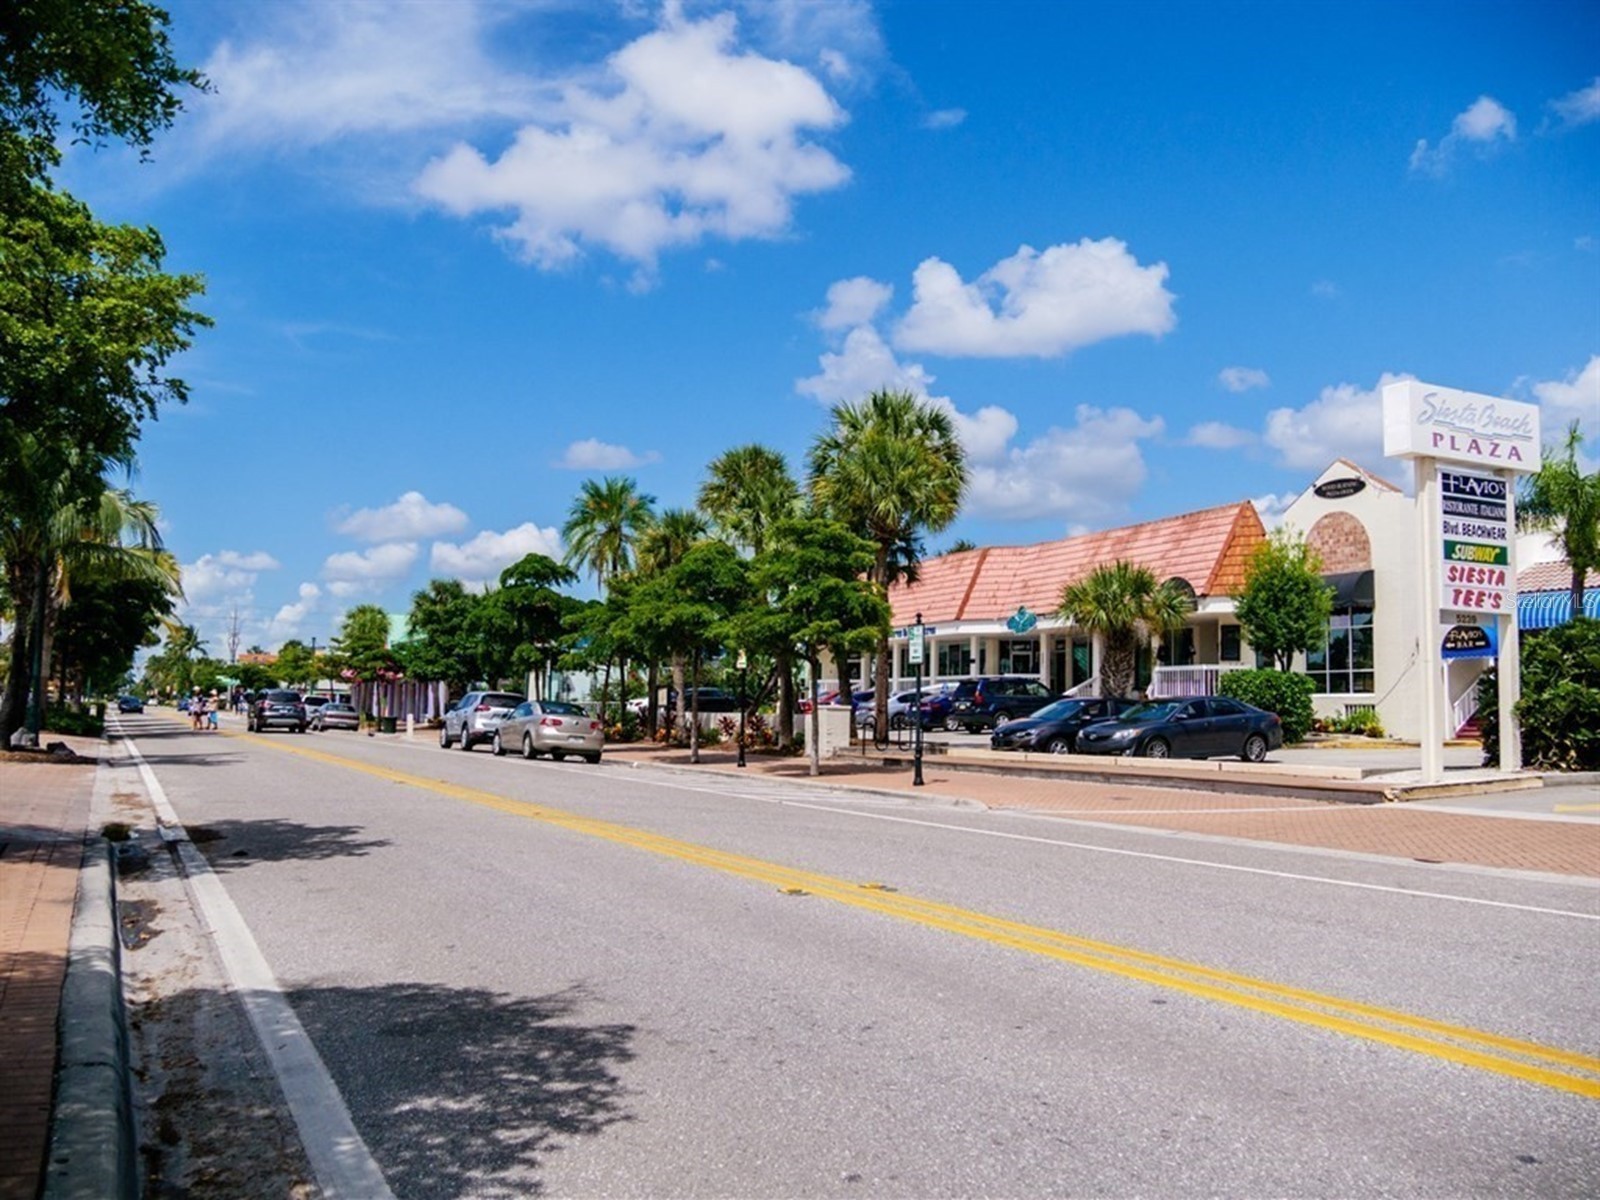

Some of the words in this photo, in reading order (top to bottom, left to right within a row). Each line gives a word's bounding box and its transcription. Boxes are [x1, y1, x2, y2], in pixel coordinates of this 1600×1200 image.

[1416, 392, 1477, 425] Siesta
[1477, 403, 1533, 434] Beach
[1431, 432, 1523, 462] PLAZA
[1462, 522, 1507, 540] BEACHWEAR
[1451, 543, 1500, 562] SUBWAY
[1447, 565, 1506, 586] SIESTA
[1452, 588, 1502, 609] TEE'S
